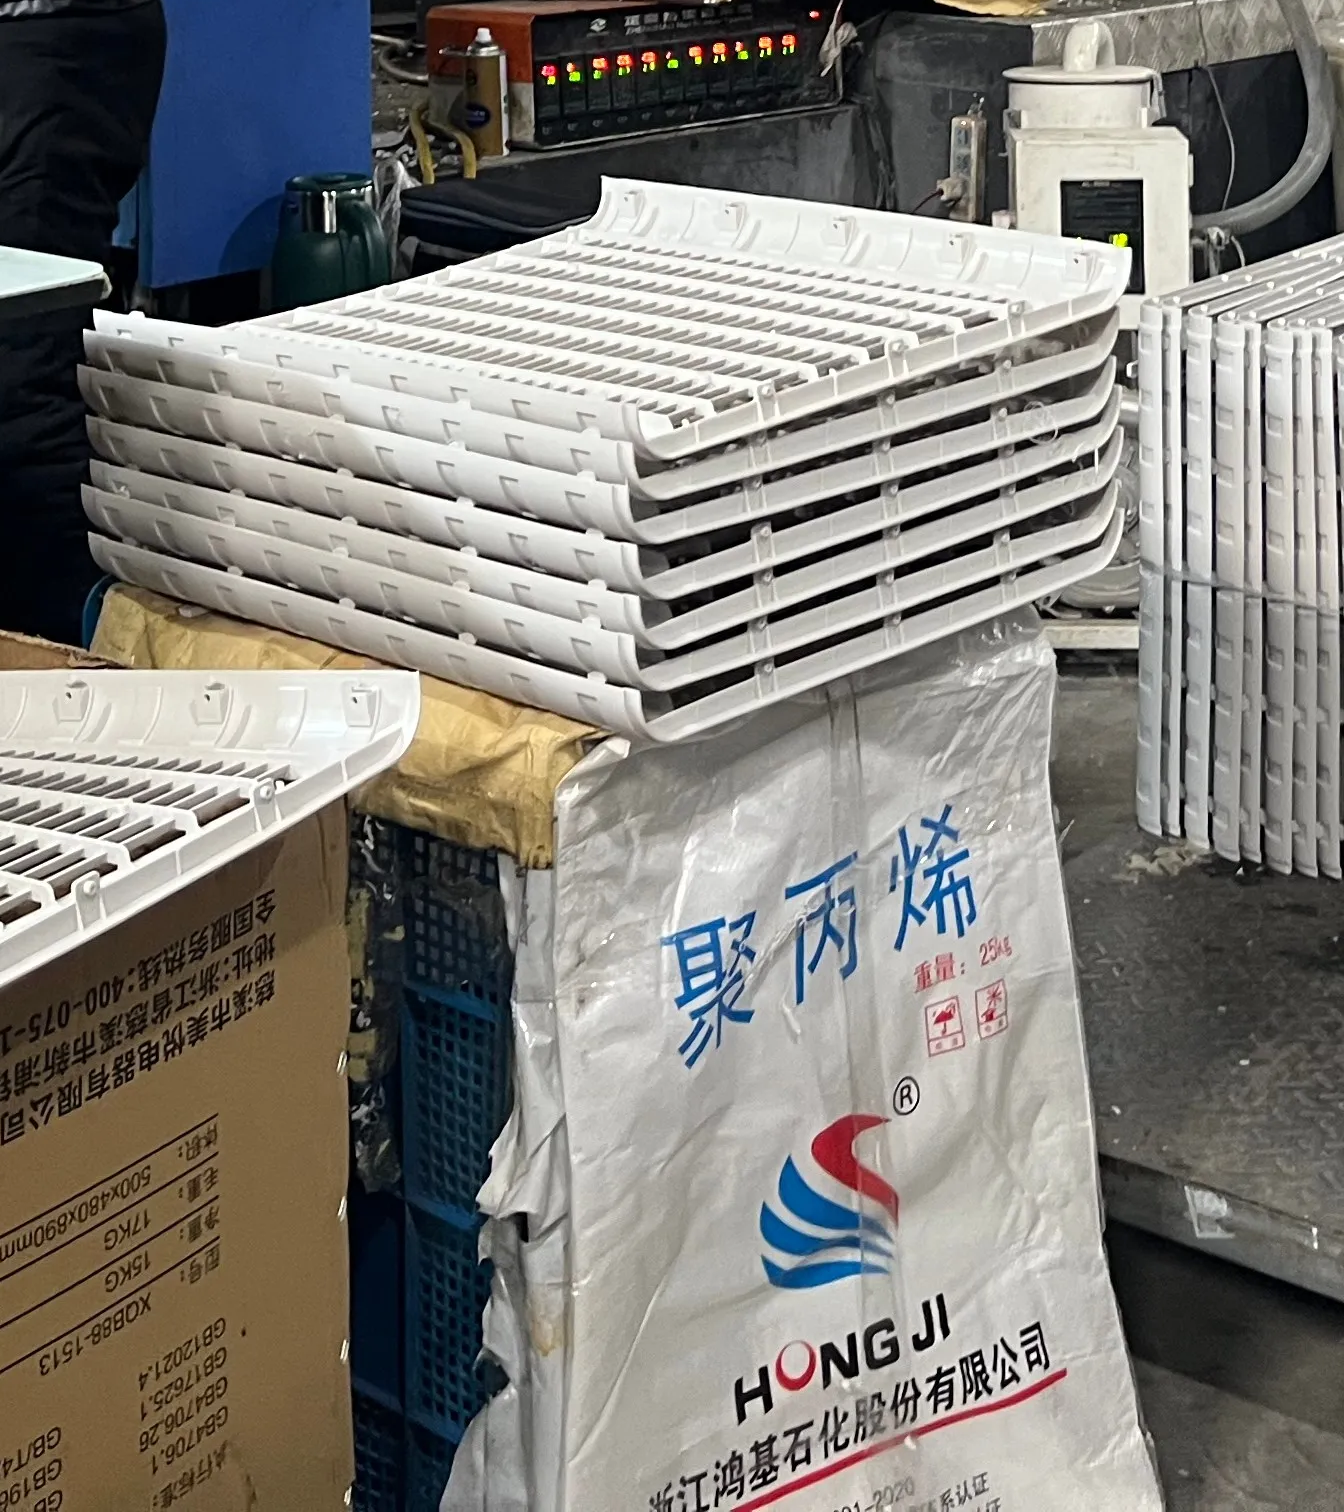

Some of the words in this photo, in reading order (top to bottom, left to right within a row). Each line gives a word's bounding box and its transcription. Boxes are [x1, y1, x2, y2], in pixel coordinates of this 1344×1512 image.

[660, 804, 978, 1069] 聚丙烯
[102, 1207, 152, 1252] 17KG
[103, 1250, 152, 1293] 15KG
[38, 1293, 152, 1377] XQB88-1513
[138, 1317, 227, 1393] GB12021.4
[140, 1347, 228, 1422] GB17625.1
[648, 1320, 1051, 1512] 浙江鸿基石化股份有限公司
[152, 1405, 229, 1476] GB4706.1
